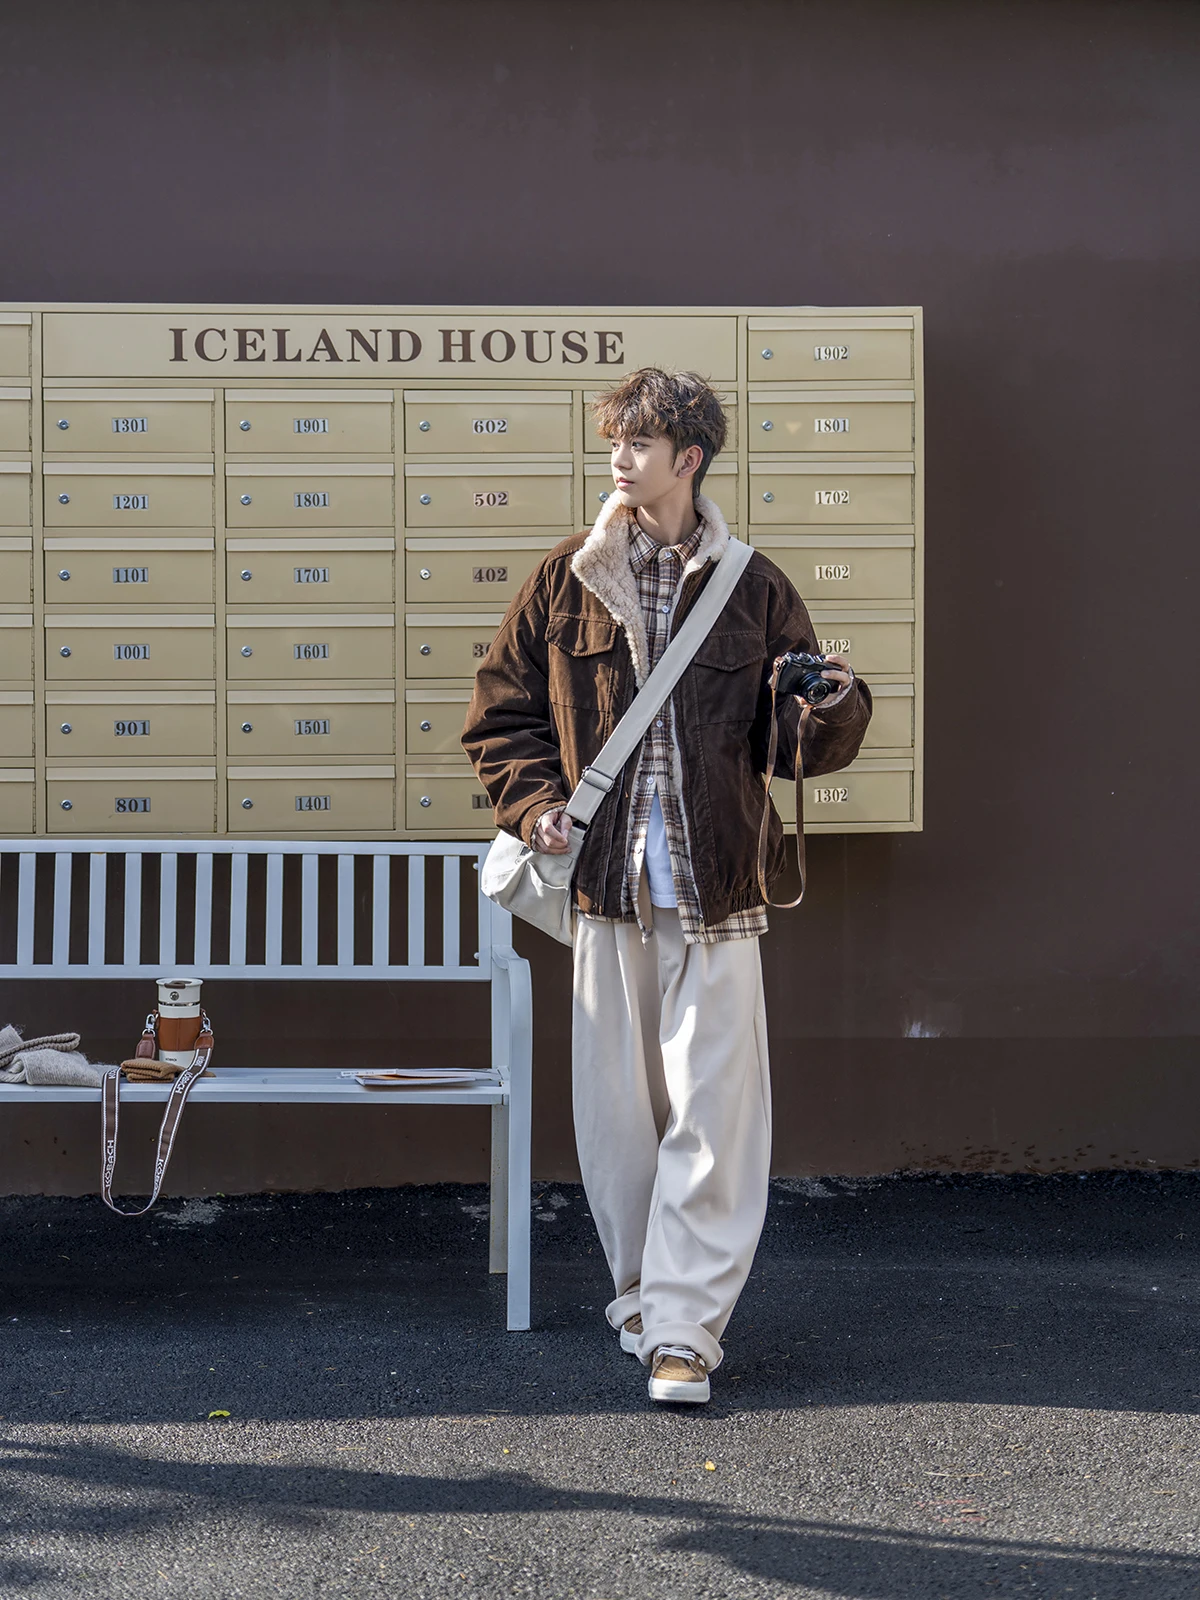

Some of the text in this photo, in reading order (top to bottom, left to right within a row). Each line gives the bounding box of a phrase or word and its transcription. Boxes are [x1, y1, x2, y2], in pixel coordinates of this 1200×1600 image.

[169, 327, 624, 365] ICELAND HOUSE
[816, 346, 847, 360] 1902
[115, 419, 145, 432] 1301
[297, 420, 327, 433] 1901
[474, 420, 506, 433] 602
[817, 420, 847, 432] 1801
[116, 496, 146, 509] 1201
[297, 494, 327, 507] 1801
[475, 492, 508, 506] 502
[817, 491, 848, 504] 1702
[116, 569, 146, 582] 1101
[297, 569, 327, 582] 1701
[473, 568, 507, 582] 402
[818, 566, 849, 579] 1602
[117, 645, 149, 659] 1001
[297, 645, 327, 659] 1601
[819, 639, 850, 653] 1502
[116, 722, 148, 735] 901
[298, 721, 328, 734] 1501
[817, 788, 848, 802] 1302
[117, 799, 149, 812] 801
[298, 797, 329, 811] 1401
[105, 1139, 114, 1188] KOBACH
